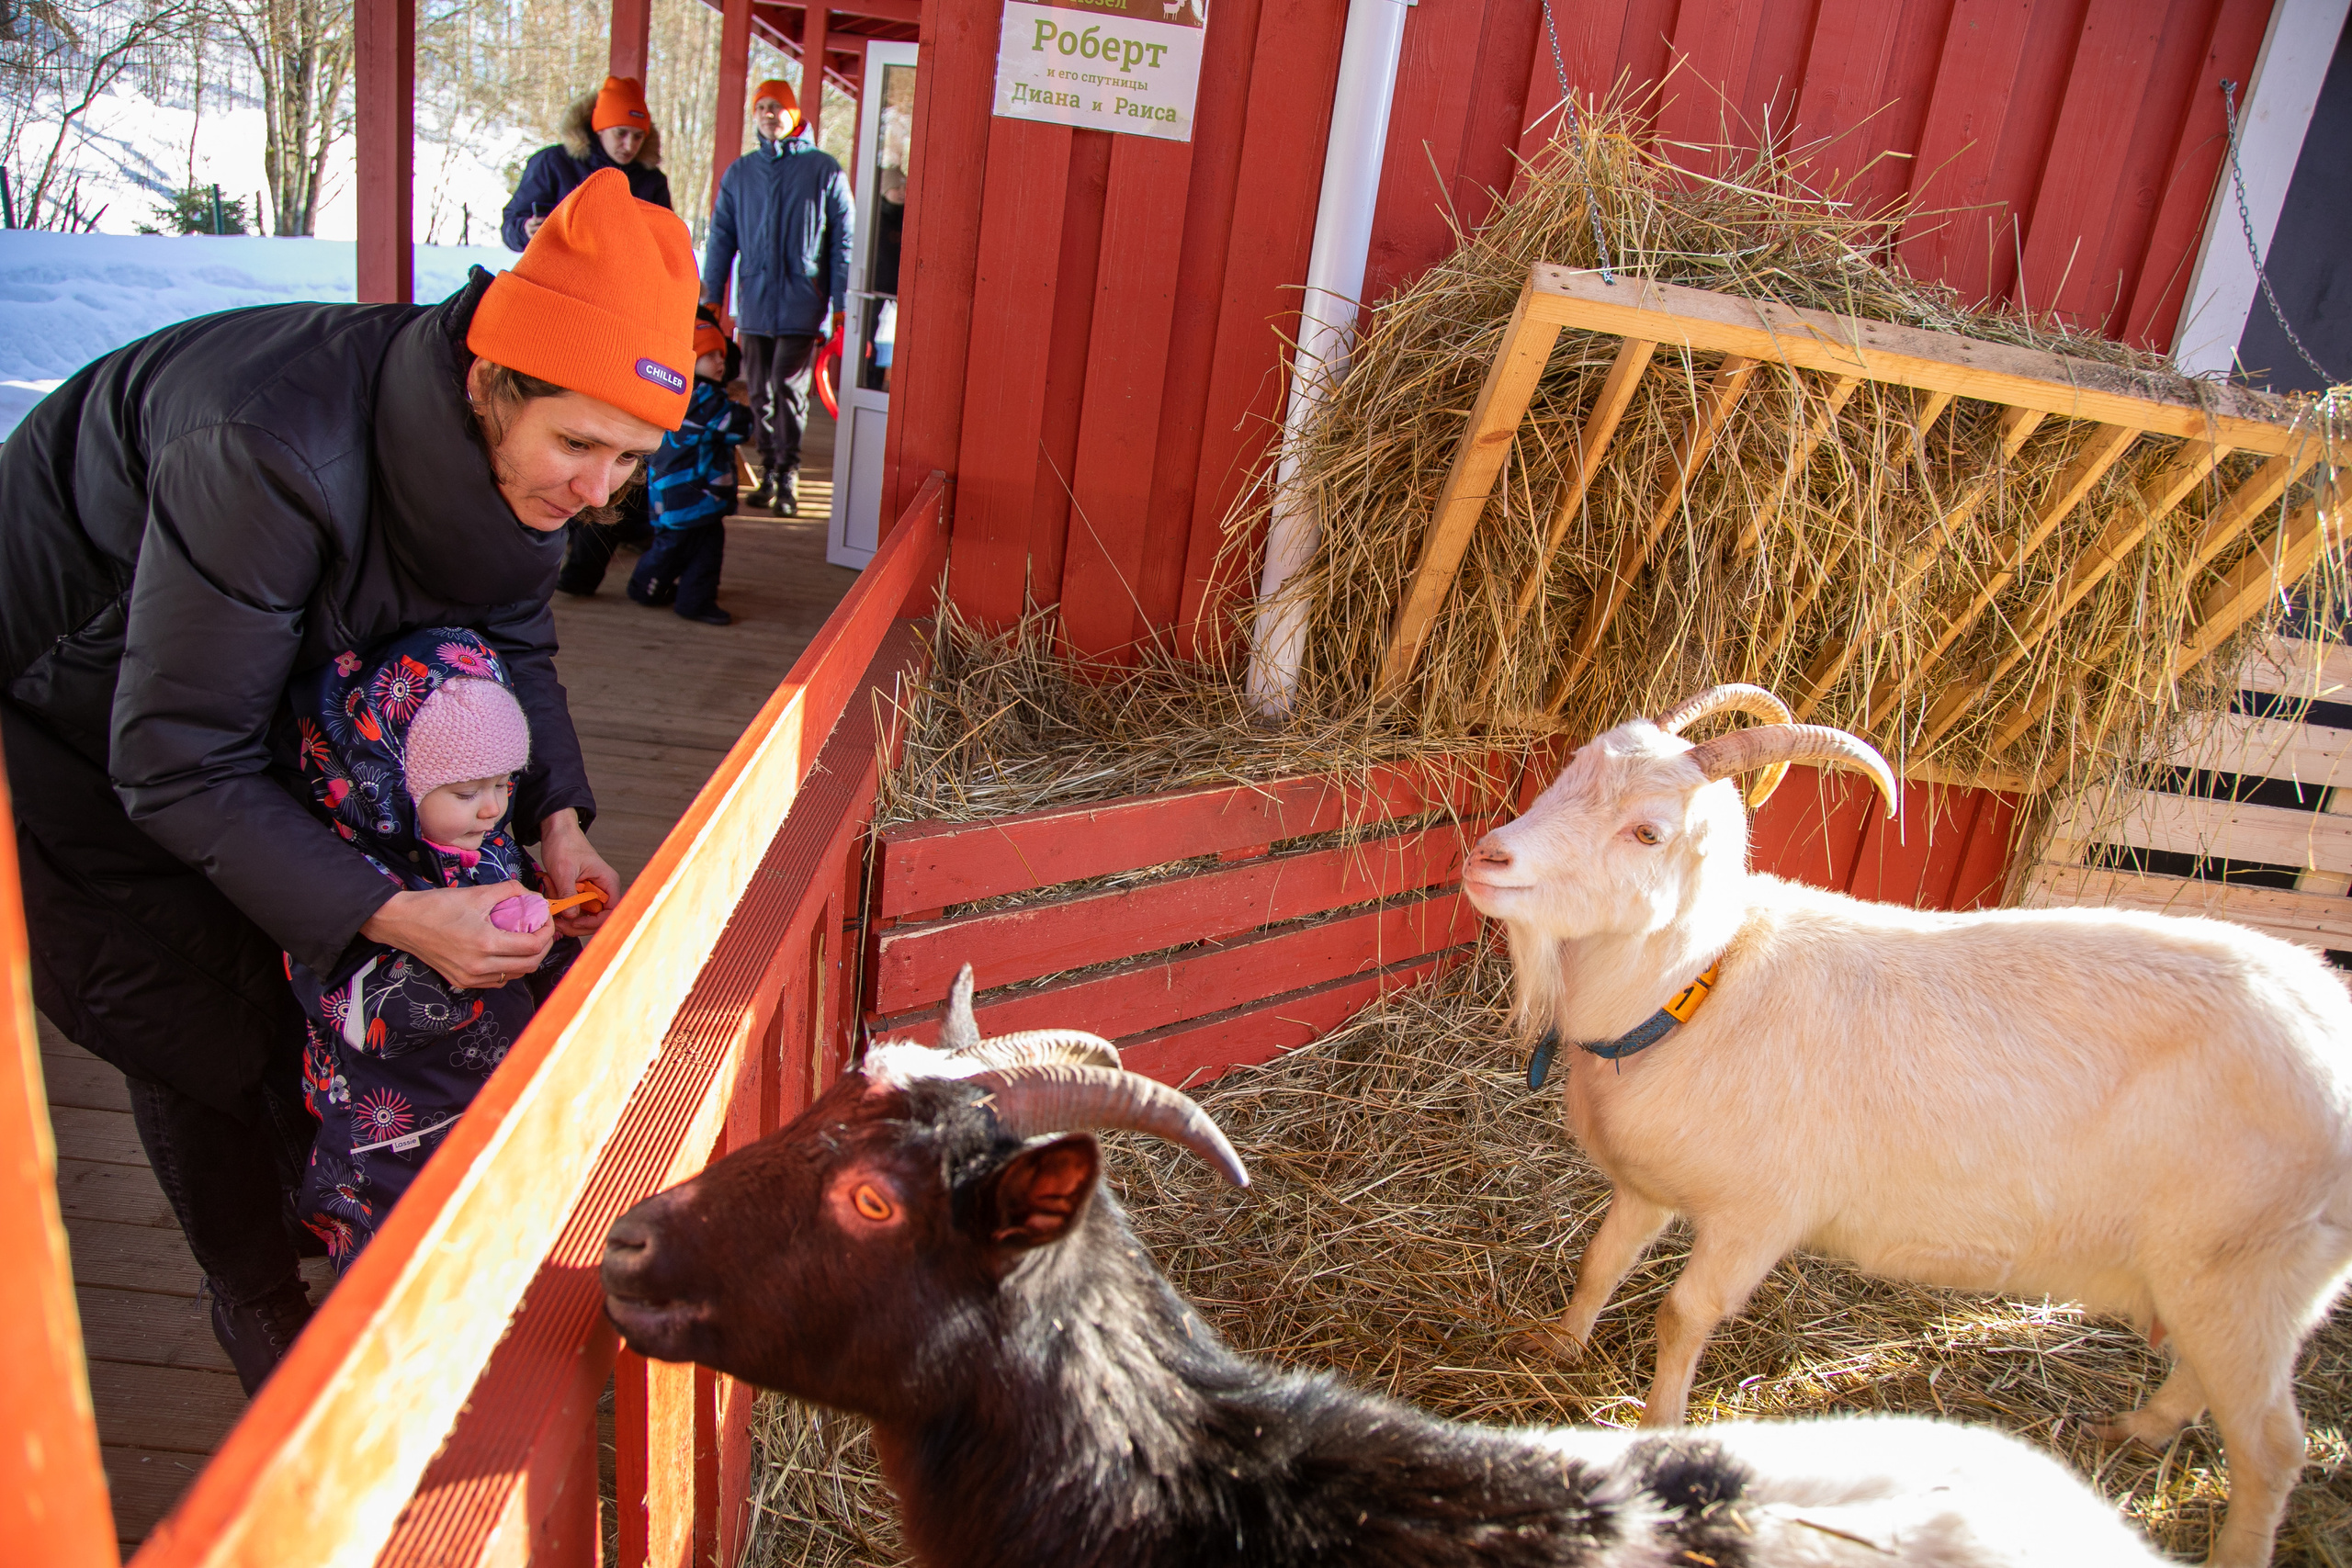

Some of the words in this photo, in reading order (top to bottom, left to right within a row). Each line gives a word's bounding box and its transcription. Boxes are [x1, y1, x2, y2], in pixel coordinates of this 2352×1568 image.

[1069, 0, 1127, 9] озел
[1032, 18, 1168, 73] Роберт
[1046, 68, 1056, 78] и
[1058, 70, 1079, 81] его
[1081, 73, 1148, 91] спутницы
[1012, 82, 1080, 108] Диана
[1091, 100, 1103, 112] и
[1114, 96, 1177, 123] Раиса
[646, 365, 684, 389] CHILLER
[395, 1138, 417, 1148] Lassie
